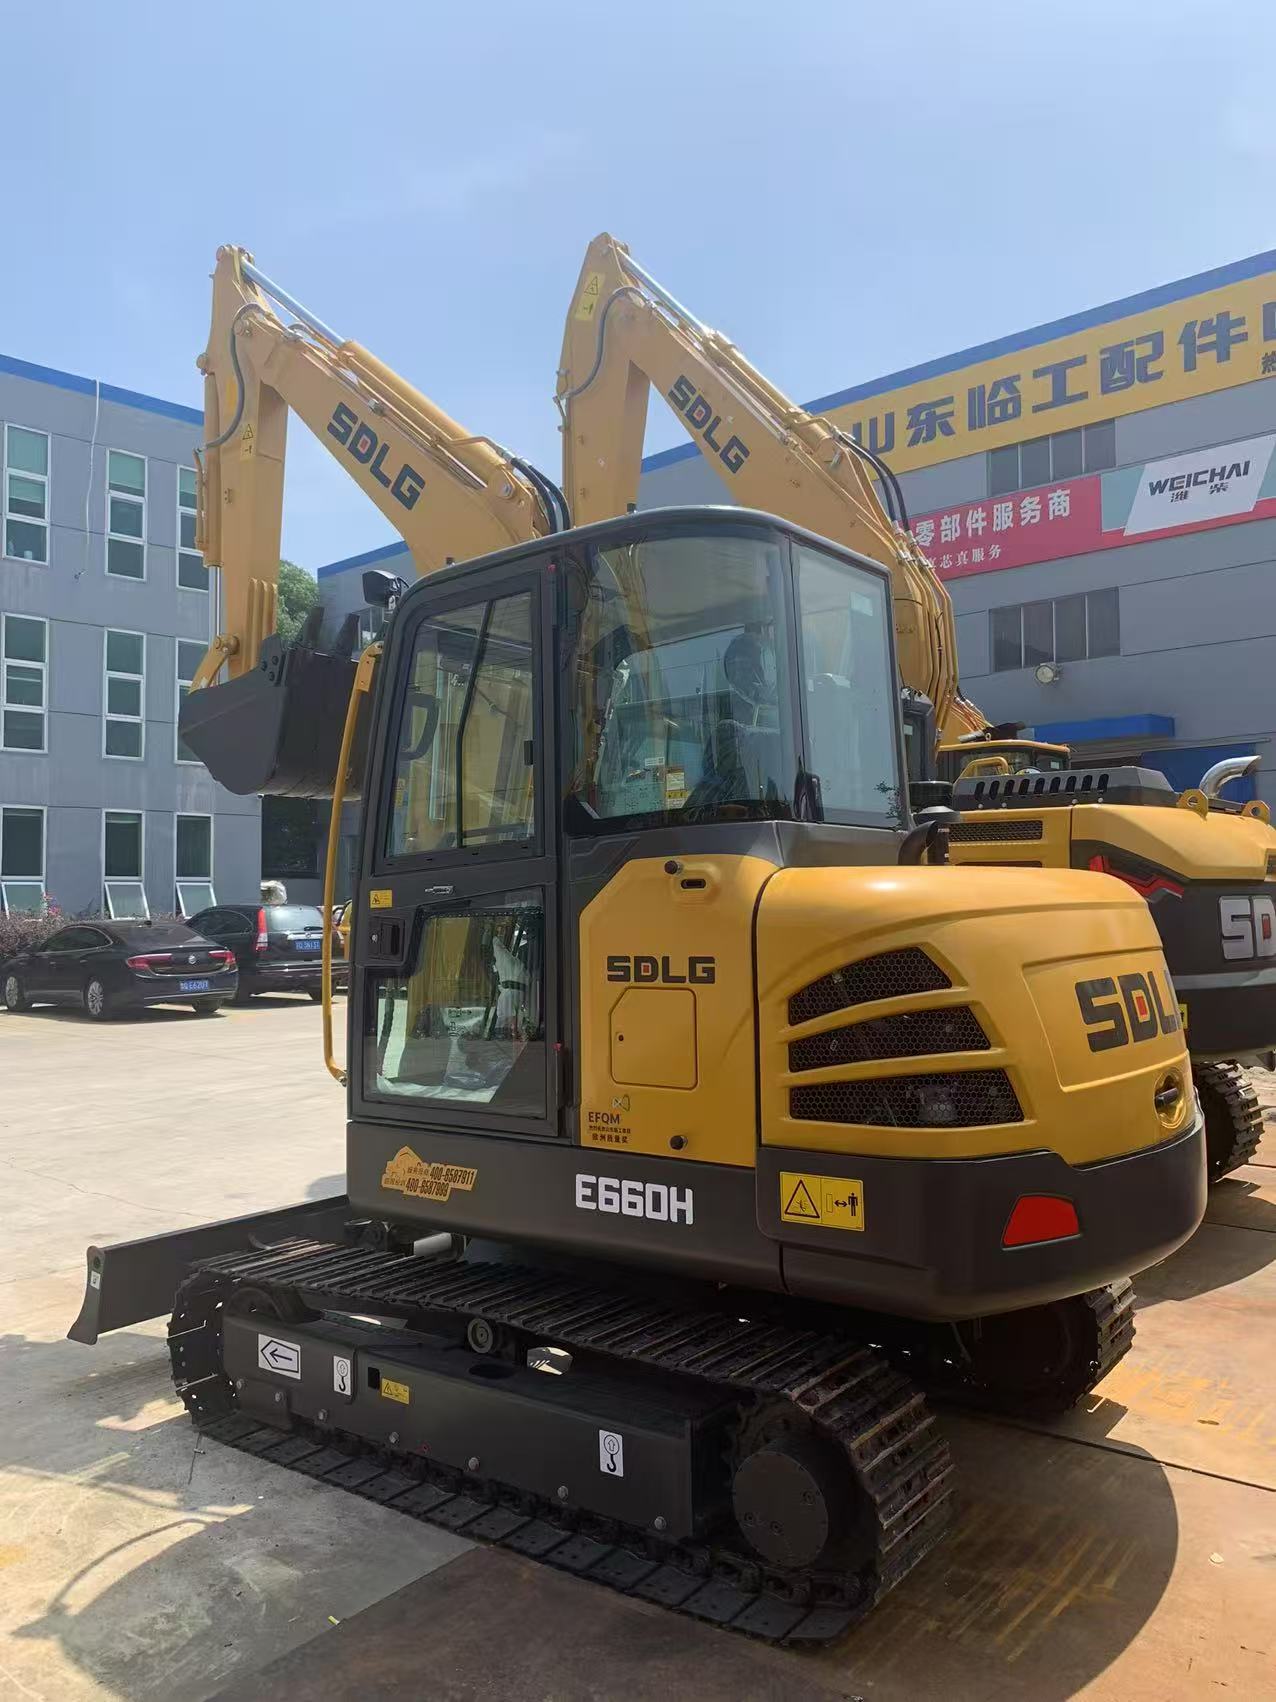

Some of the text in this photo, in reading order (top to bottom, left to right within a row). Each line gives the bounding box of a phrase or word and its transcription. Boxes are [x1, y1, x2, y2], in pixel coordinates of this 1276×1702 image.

[852, 301, 1276, 455] 山东临工配件
[667, 375, 750, 474] SDLG
[327, 401, 426, 510] SDLG
[1149, 460, 1250, 496] WEICHAI
[915, 489, 1071, 547] 零部件服务商
[607, 955, 715, 984] SDLG
[1075, 970, 1181, 1053] SDL
[588, 1111, 620, 1124] EFQM
[575, 1173, 693, 1225] E660H
